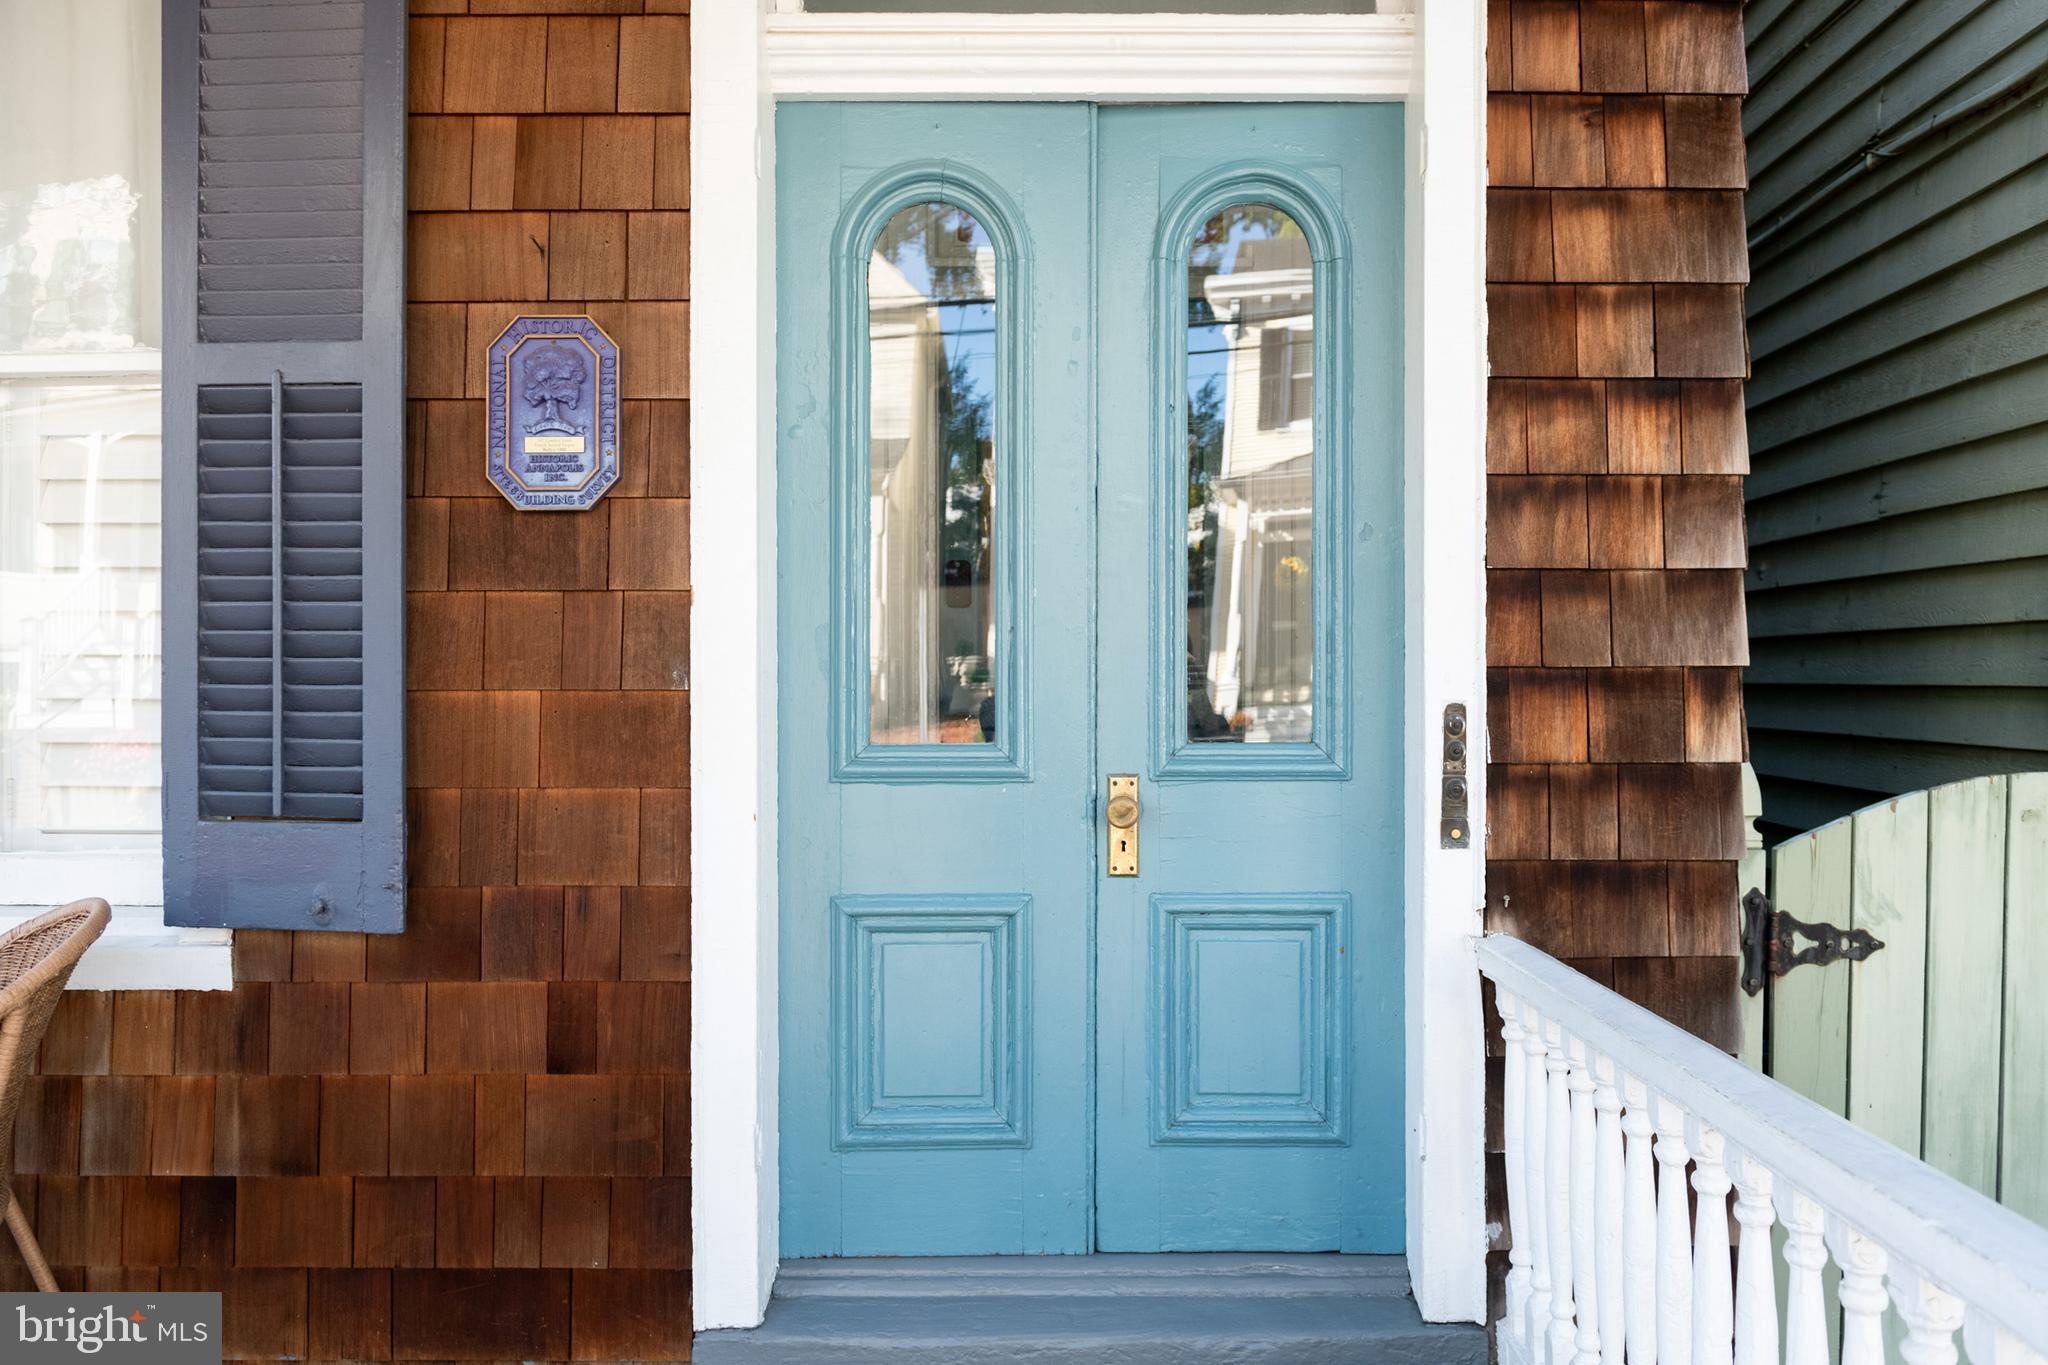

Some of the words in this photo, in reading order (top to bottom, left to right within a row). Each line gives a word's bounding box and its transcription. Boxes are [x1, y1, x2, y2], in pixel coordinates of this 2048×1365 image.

[507, 320, 598, 344] HISTORIC
[491, 355, 507, 449] NATIONAL
[600, 355, 616, 446] DISTRICT
[525, 464, 585, 473] ANNAPOLIS
[529, 455, 580, 464] HISTORIC
[514, 491, 576, 506] BUILDING
[578, 464, 616, 505] SURVEY
[543, 473, 569, 482] INC.
